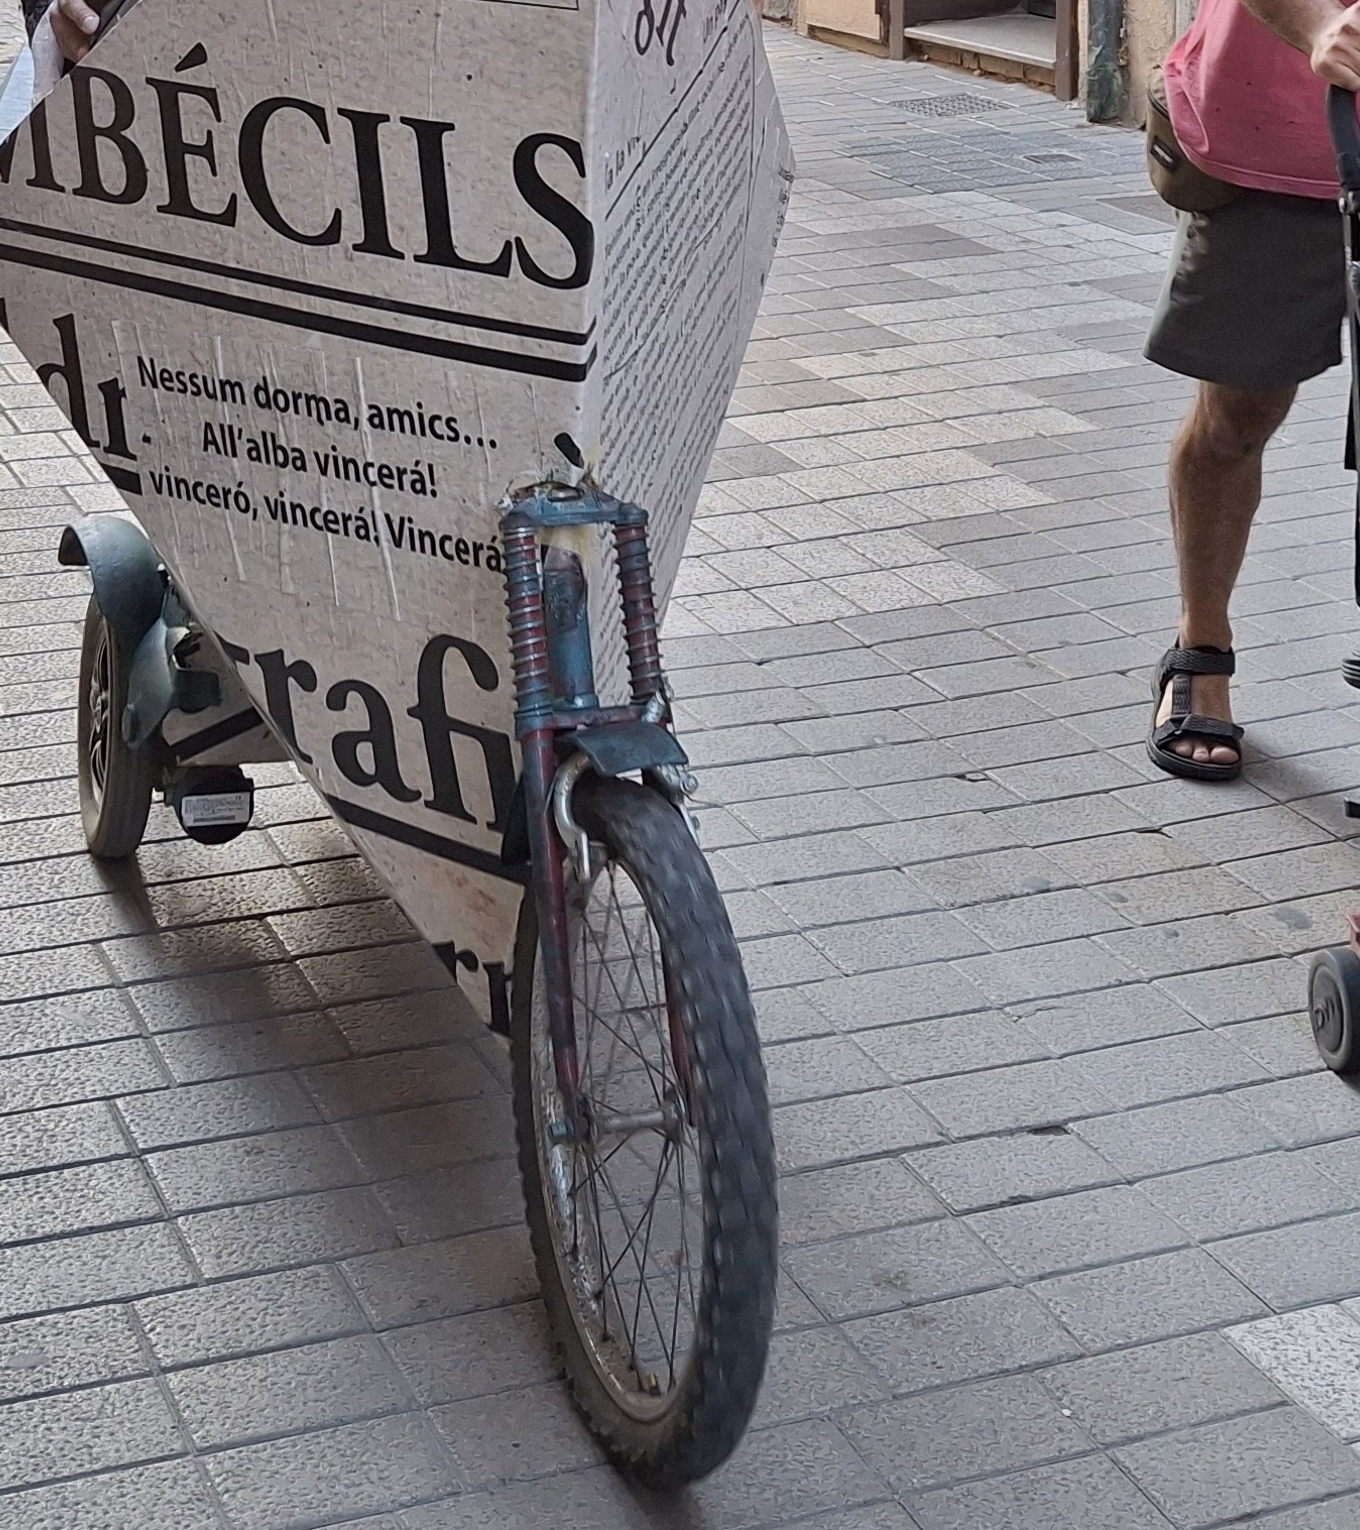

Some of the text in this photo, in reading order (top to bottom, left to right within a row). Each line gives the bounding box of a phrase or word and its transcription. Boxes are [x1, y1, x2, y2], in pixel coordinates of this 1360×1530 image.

[136, 355, 247, 407] Nessum
[253, 377, 361, 430] dorma,
[313, 447, 439, 499] vincerá!
[149, 464, 504, 573] vinceró, vincerá! Vincerá
